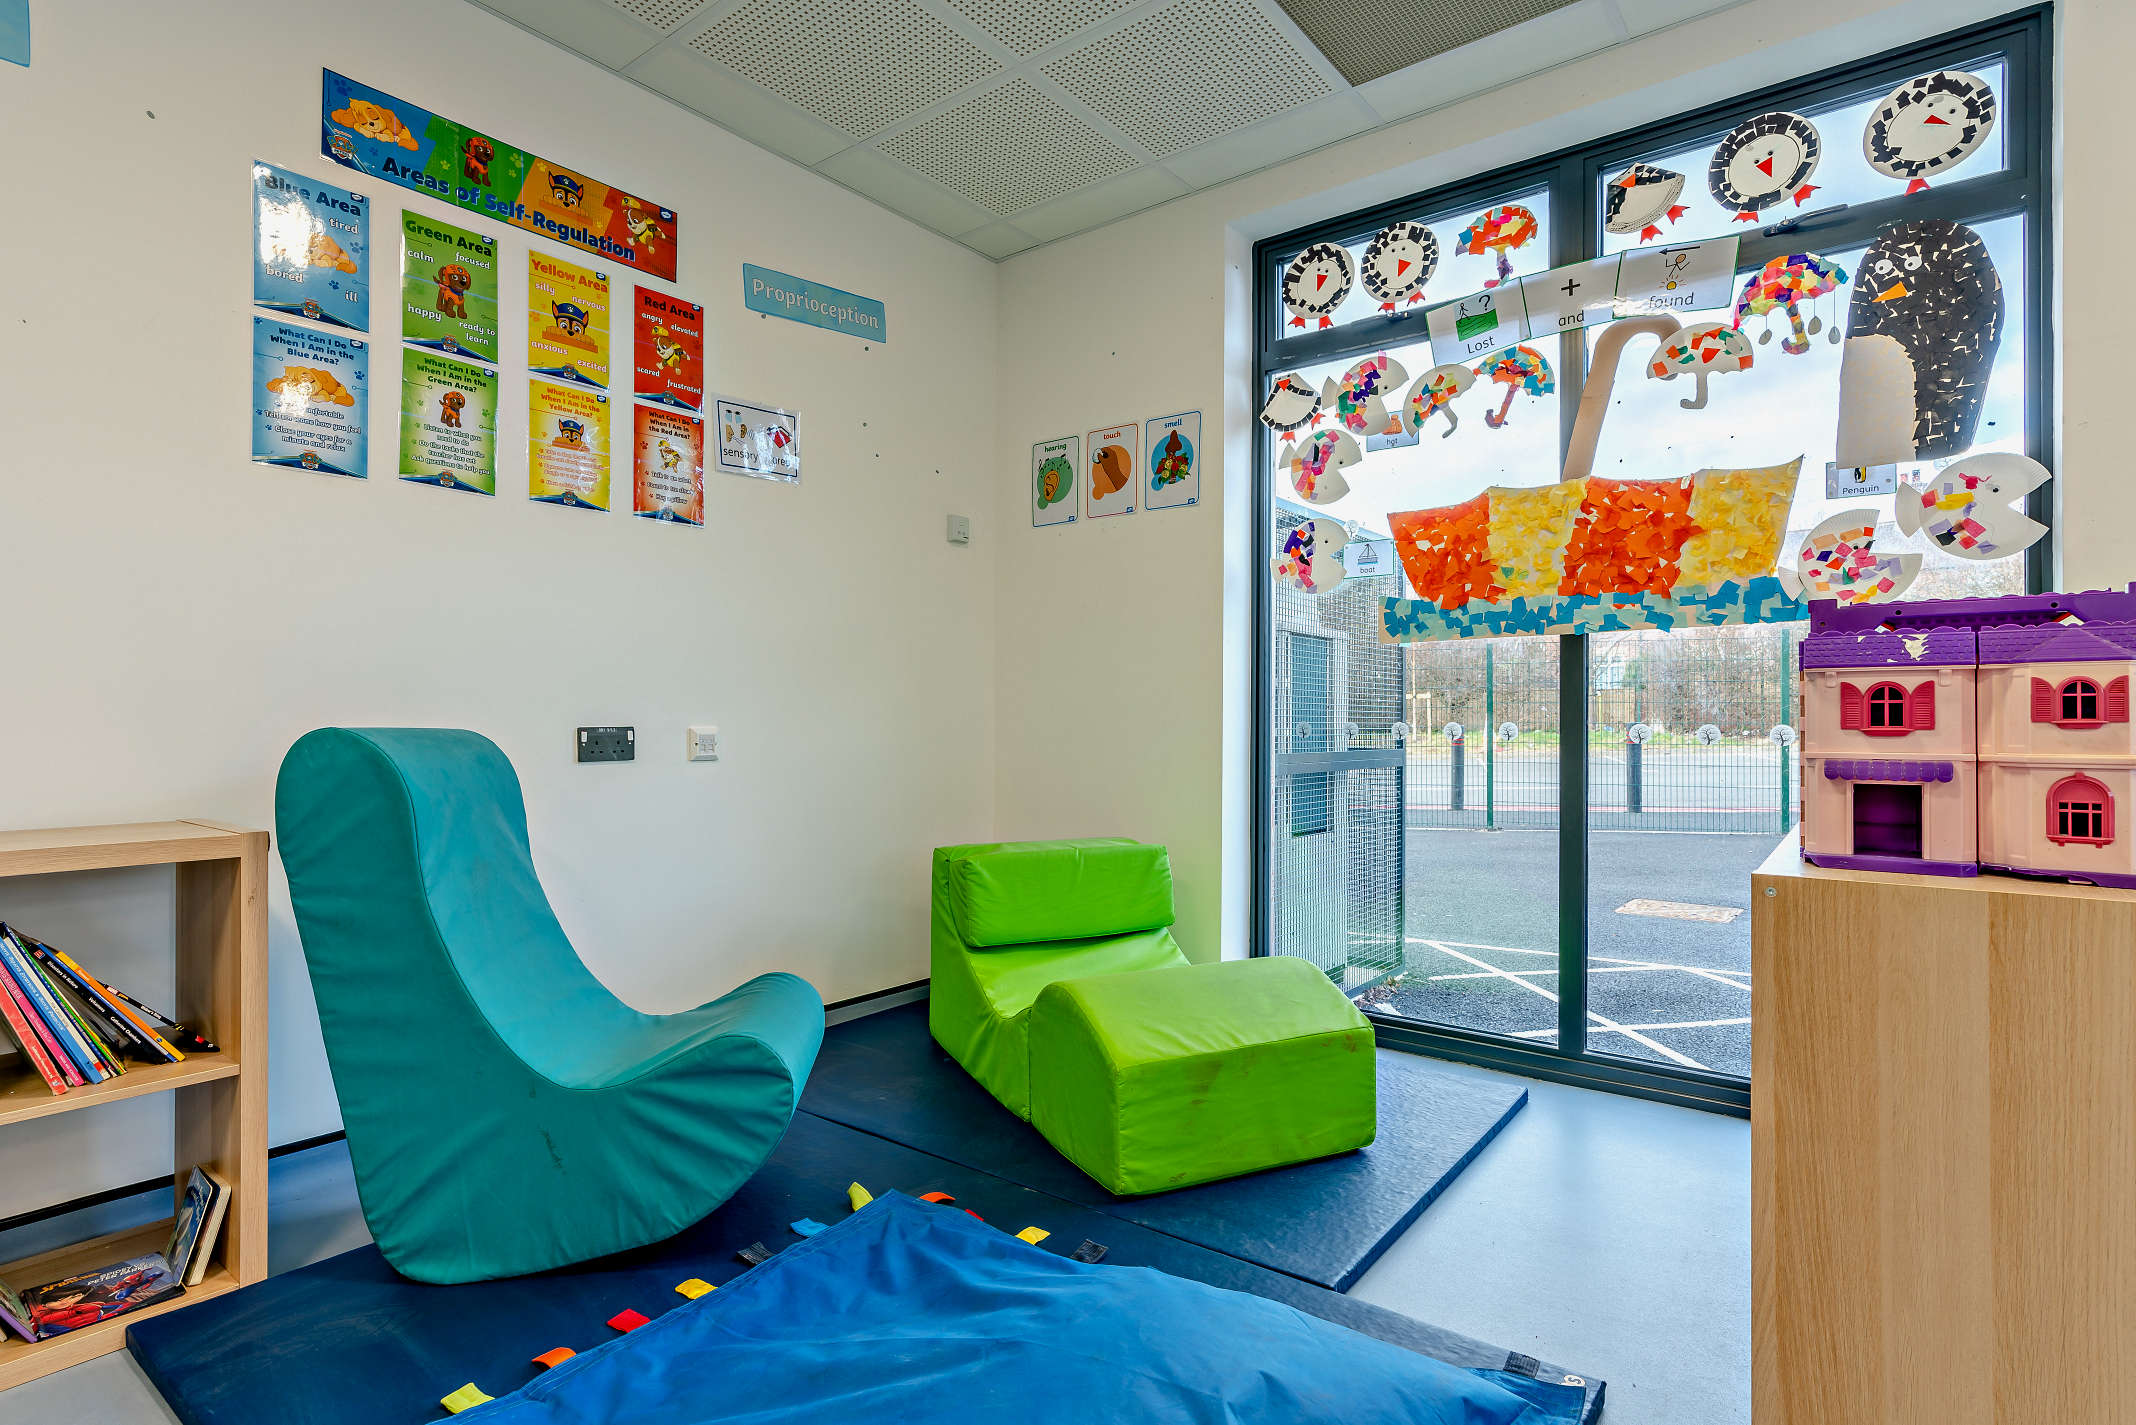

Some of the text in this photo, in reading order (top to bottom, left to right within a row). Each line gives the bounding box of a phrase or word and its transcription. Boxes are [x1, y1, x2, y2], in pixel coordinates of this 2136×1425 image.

[265, 175, 311, 200] Blue
[316, 191, 362, 217] Area
[381, 156, 636, 262] Areas of Self-Regulation
[328, 217, 360, 235] tired
[405, 220, 492, 257] Green Area
[407, 250, 490, 270] calm focused
[265, 264, 304, 284] bored
[531, 258, 608, 293] Yellow Area
[345, 290, 359, 303] ill
[535, 281, 555, 296] silly
[572, 295, 606, 312] nervous
[644, 295, 695, 321] Red Area
[752, 278, 879, 329] Proprioception
[1649, 292, 1694, 309] found
[407, 303, 442, 322] happy
[641, 312, 663, 325] angry
[1558, 311, 1585, 327] and
[459, 321, 496, 336] ready to
[670, 323, 699, 338] elevated
[278, 327, 305, 340] What
[305, 334, 326, 345] Can
[334, 340, 347, 350] Do
[466, 333, 489, 346] learn
[1467, 335, 1496, 355] Lost
[270, 335, 299, 347] When
[308, 343, 325, 353] Am
[327, 346, 337, 356] in
[338, 350, 355, 360] the
[531, 340, 568, 355] anxious
[287, 348, 340, 366] Blue Area?
[424, 357, 447, 369] What
[448, 363, 464, 373] Can
[471, 369, 481, 378] Do
[577, 359, 607, 373] excited
[637, 366, 660, 377] scared
[417, 364, 440, 376] When
[448, 372, 462, 380] Am
[464, 375, 472, 383] in
[474, 378, 487, 388] the
[427, 375, 477, 393] Green Area?
[667, 378, 702, 395] frustrated
[541, 393, 561, 404] When
[567, 399, 579, 408] Am
[580, 401, 587, 410] in
[588, 404, 600, 413] the
[547, 387, 566, 397] What
[567, 391, 580, 400] Can
[586, 396, 595, 404] Do
[549, 403, 593, 419] Yellow Area?
[648, 411, 665, 419] What
[648, 425, 660, 433] the
[661, 428, 673, 436] Red
[649, 418, 667, 427] When
[1164, 418, 1183, 429] smell
[1103, 431, 1121, 440] touch
[723, 448, 758, 463] sensory
[1044, 442, 1067, 453] hearing
[1842, 485, 1880, 495] Penguin
[1360, 566, 1376, 574] boat
